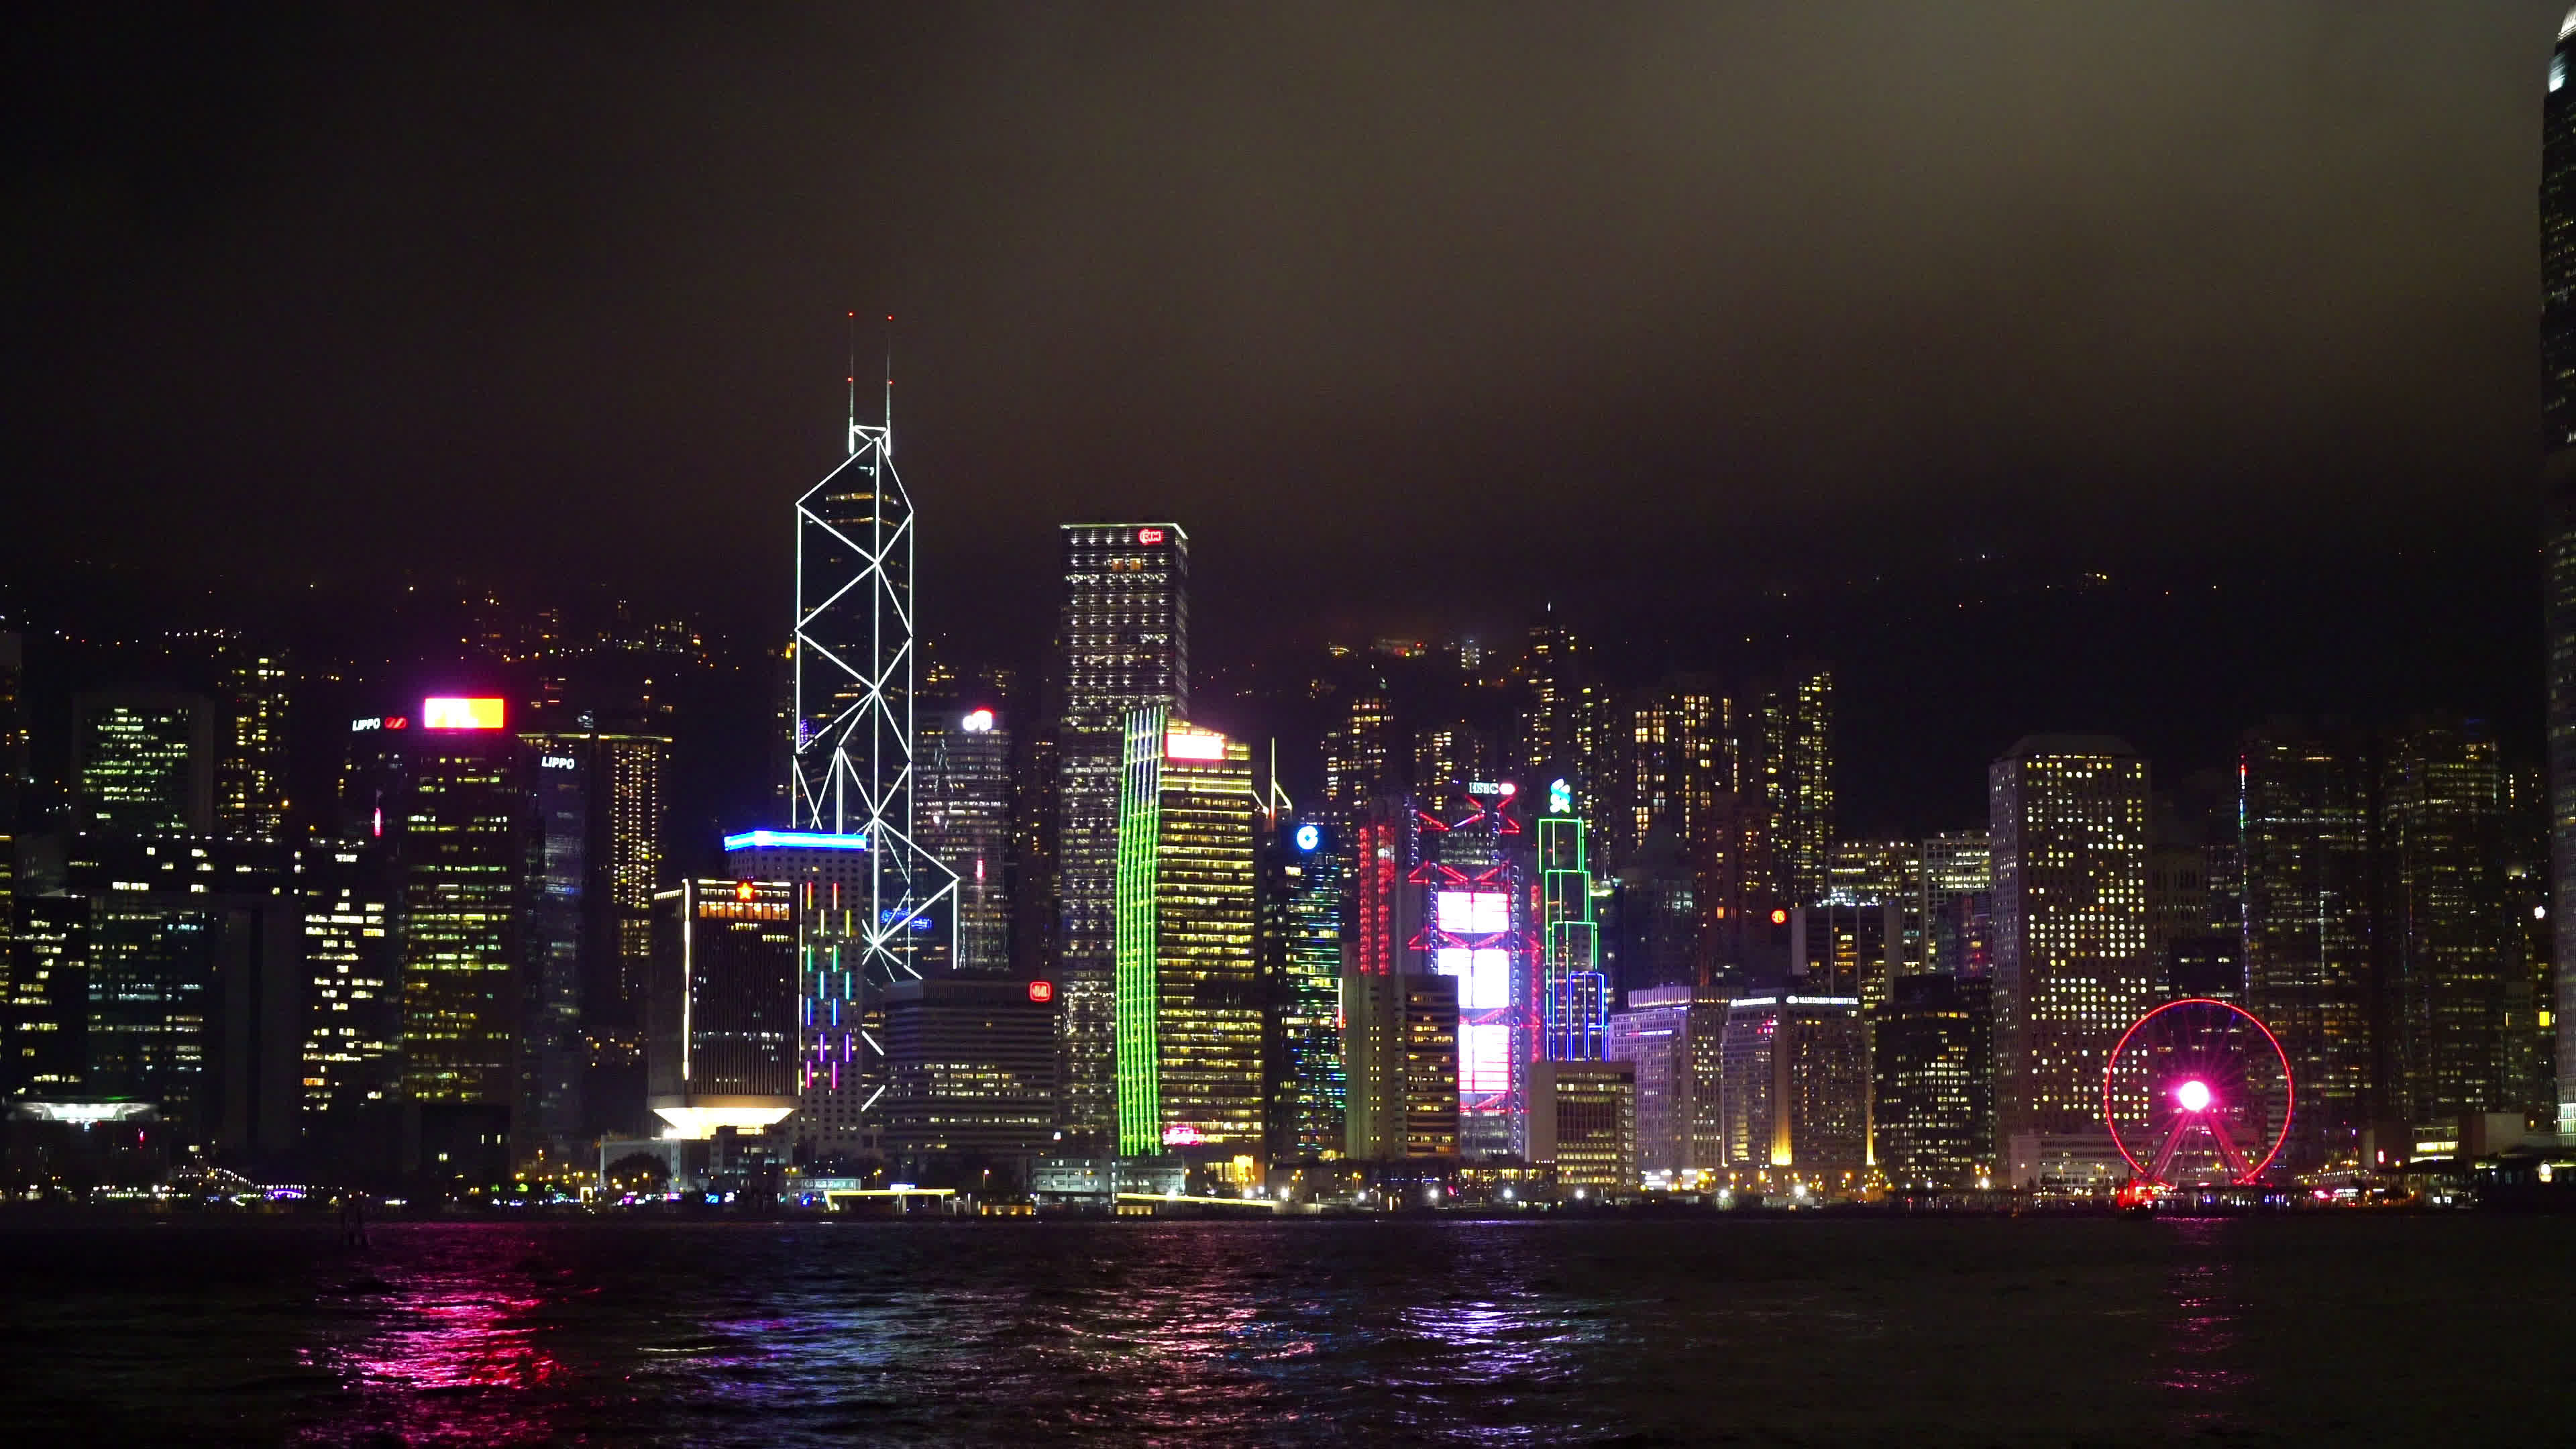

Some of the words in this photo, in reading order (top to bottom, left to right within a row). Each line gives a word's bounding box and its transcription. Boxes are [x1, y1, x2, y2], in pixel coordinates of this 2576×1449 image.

[352, 718, 380, 731] LIPPO
[541, 756, 575, 769] LIPPO
[1468, 782, 1499, 795] HSBC
